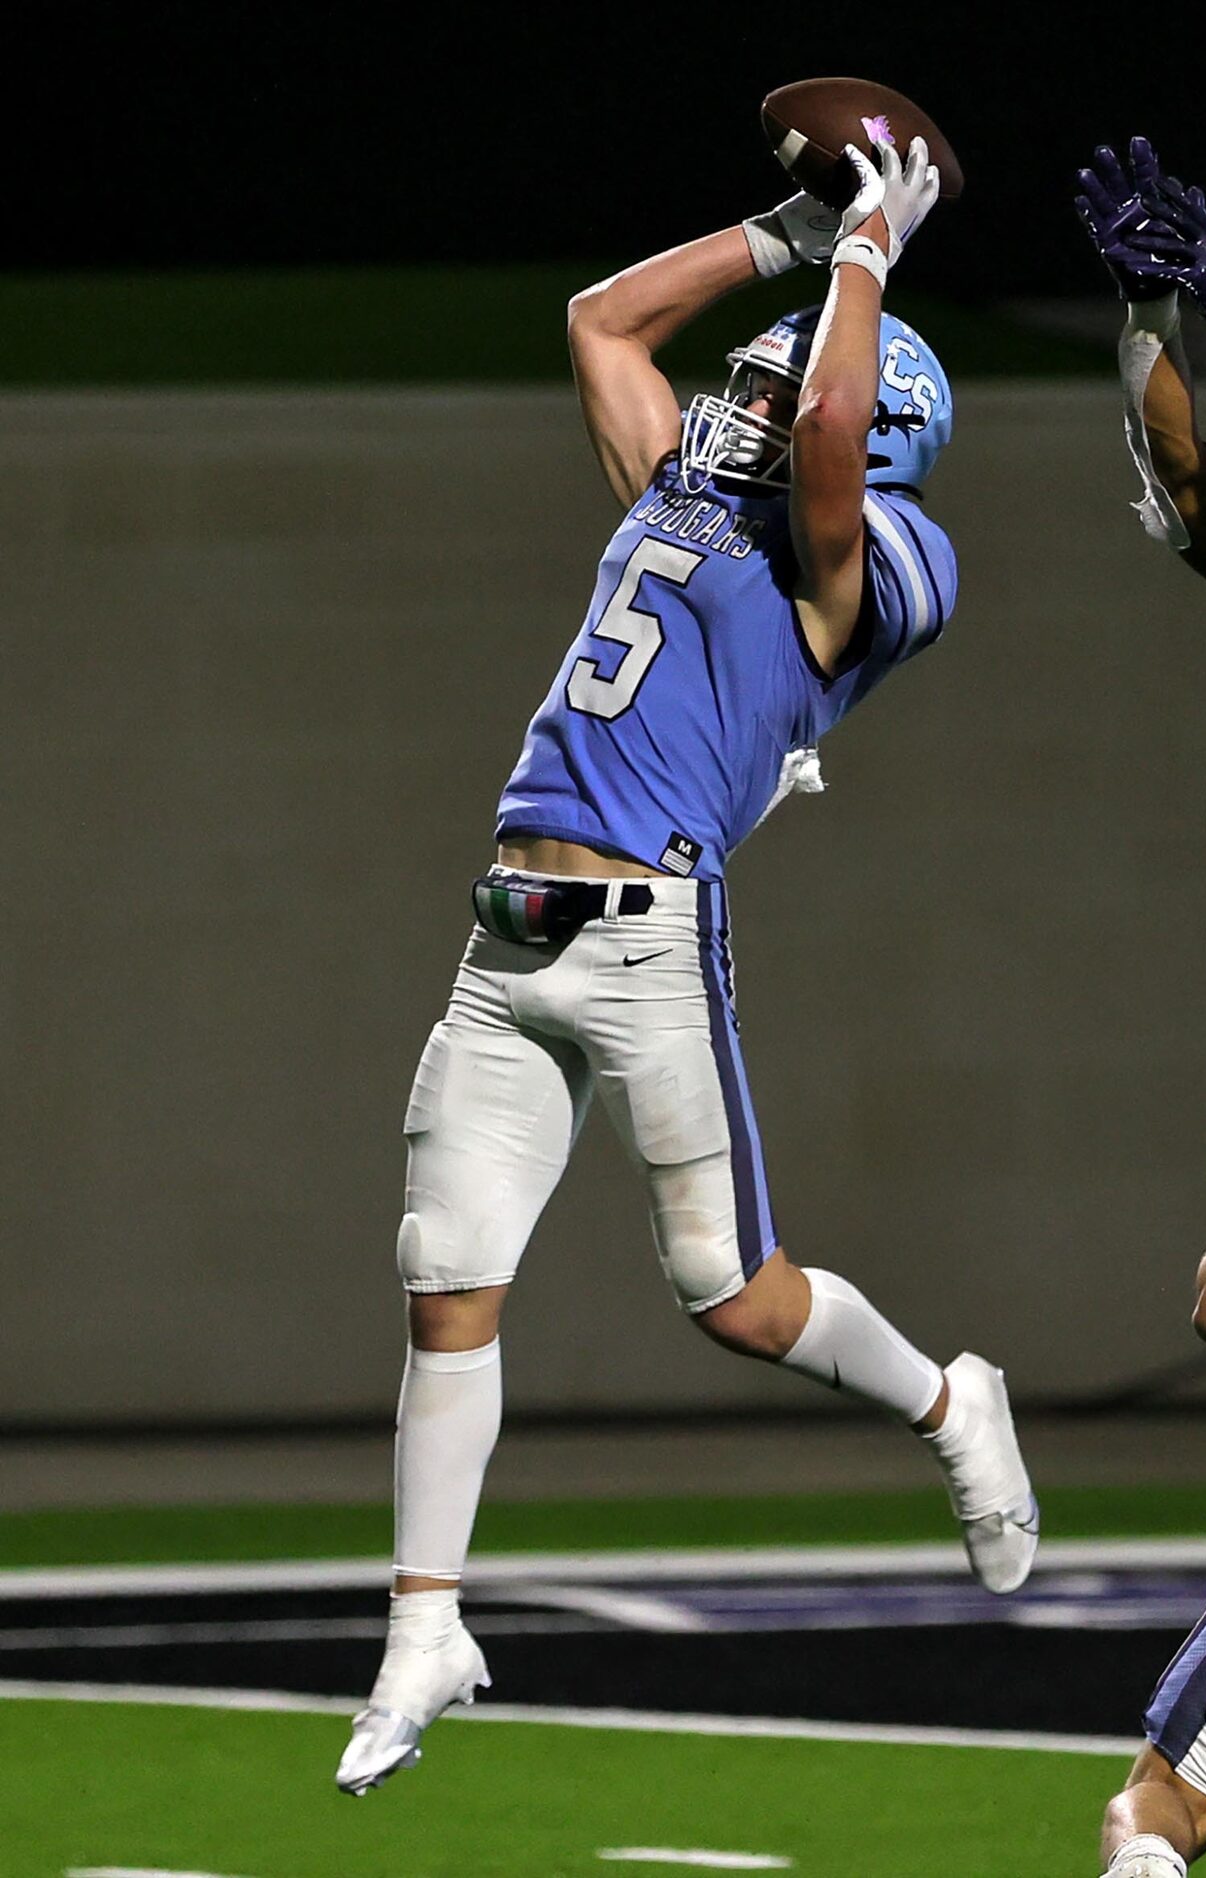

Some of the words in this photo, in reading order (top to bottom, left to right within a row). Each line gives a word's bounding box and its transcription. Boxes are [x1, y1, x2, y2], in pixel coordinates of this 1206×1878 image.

[880, 336, 938, 433] CS
[635, 490, 766, 561] COUGARS
[565, 535, 707, 723] 5
[678, 840, 692, 856] M
